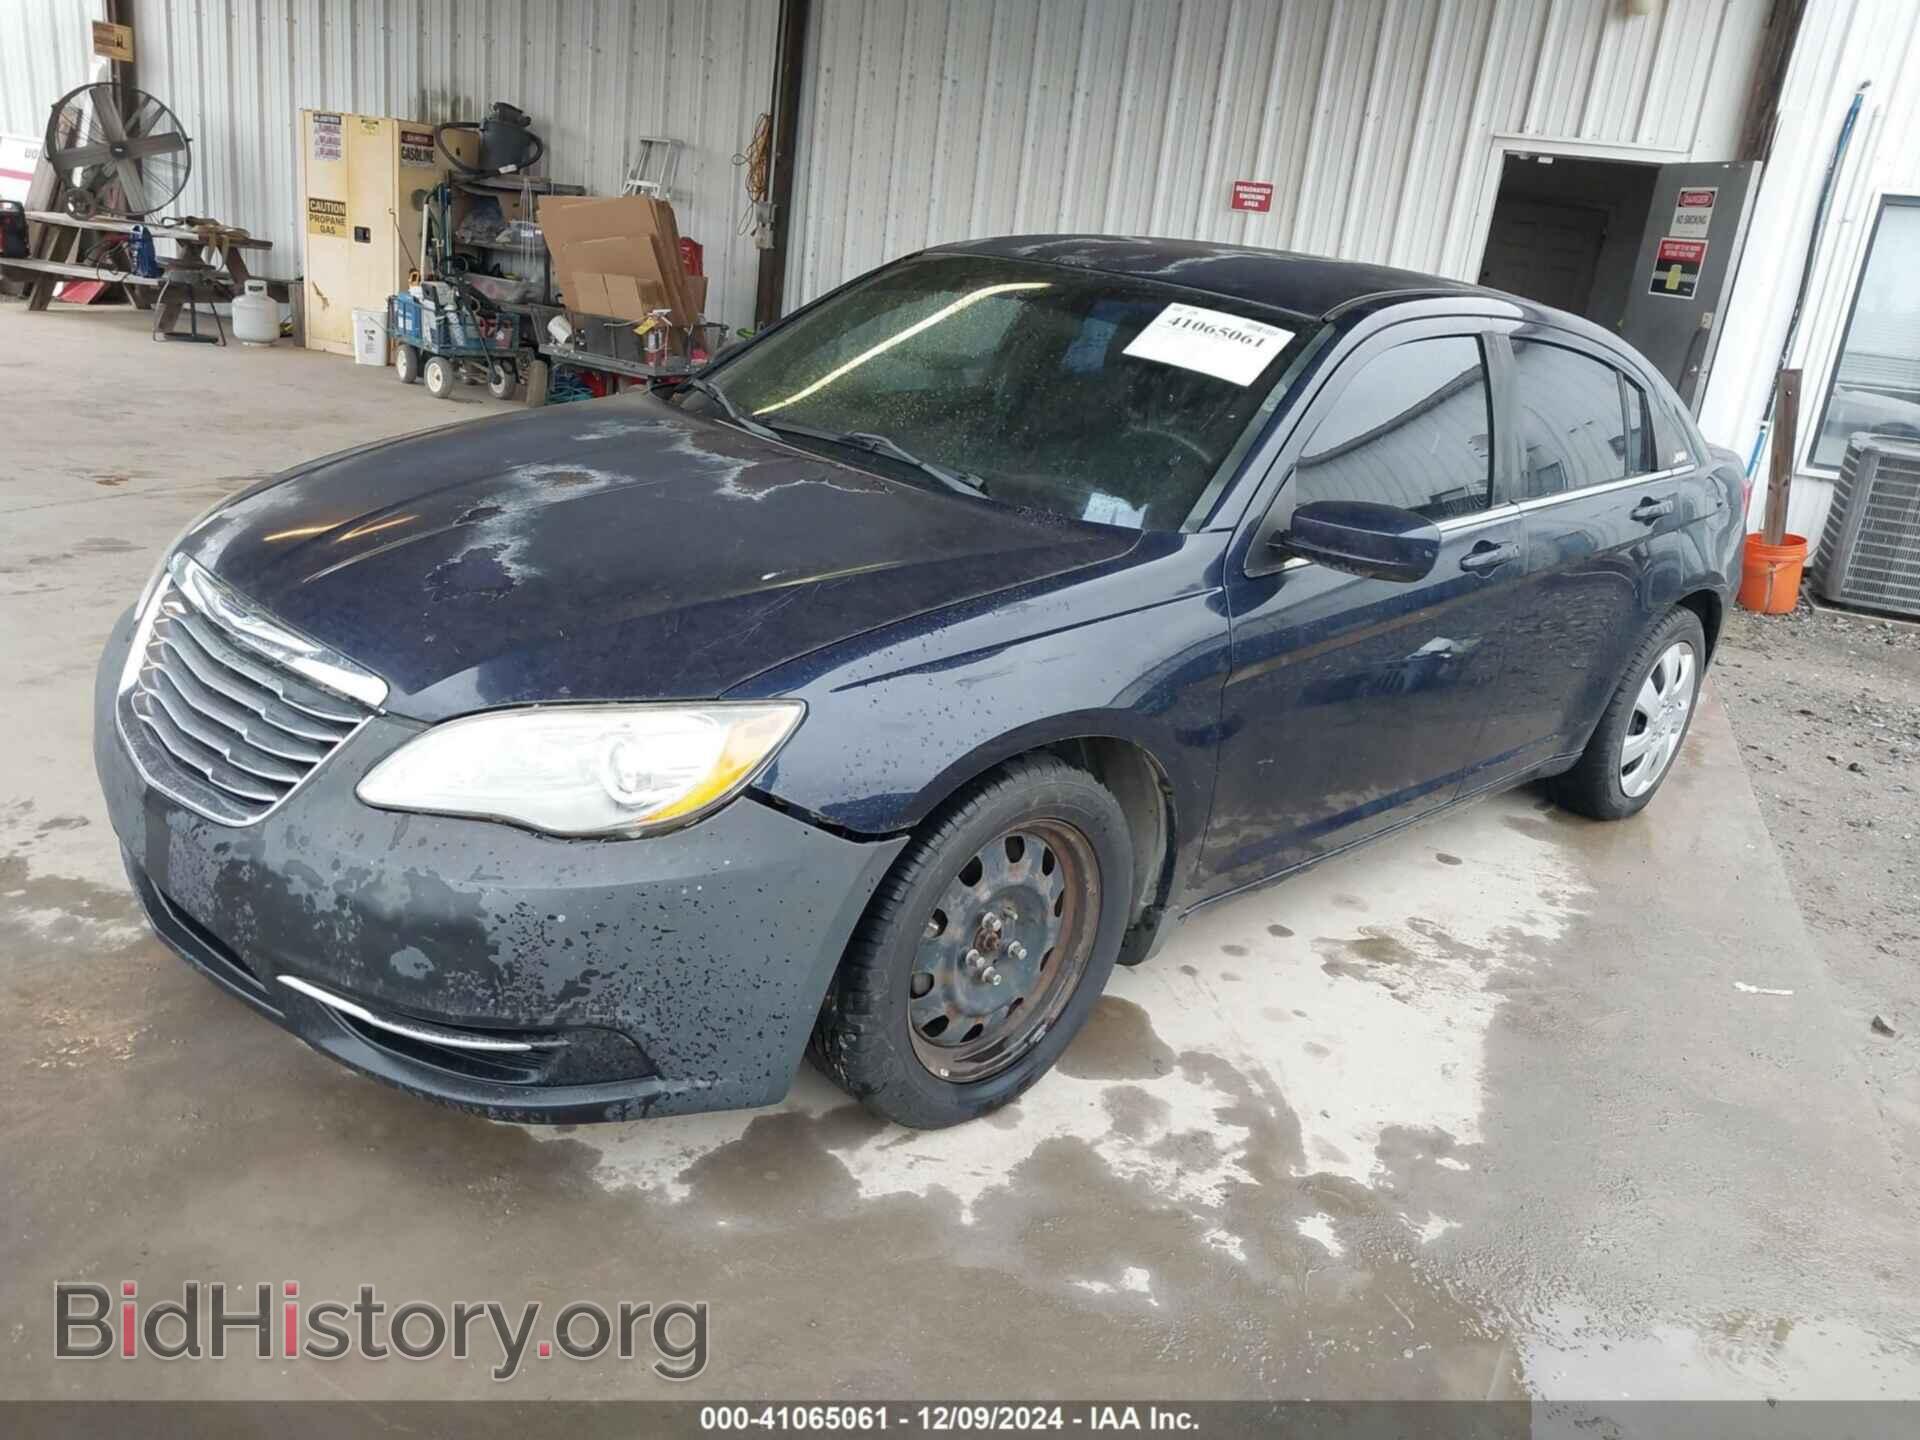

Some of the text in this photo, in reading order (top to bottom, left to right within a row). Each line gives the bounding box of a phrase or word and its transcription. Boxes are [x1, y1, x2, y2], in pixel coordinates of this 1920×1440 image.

[401, 146, 434, 162] GASOLINE
[311, 200, 345, 214] CAUTION
[309, 213, 346, 225] PROPANE
[320, 224, 336, 234] GAS
[1168, 317, 1265, 347] 41065061
